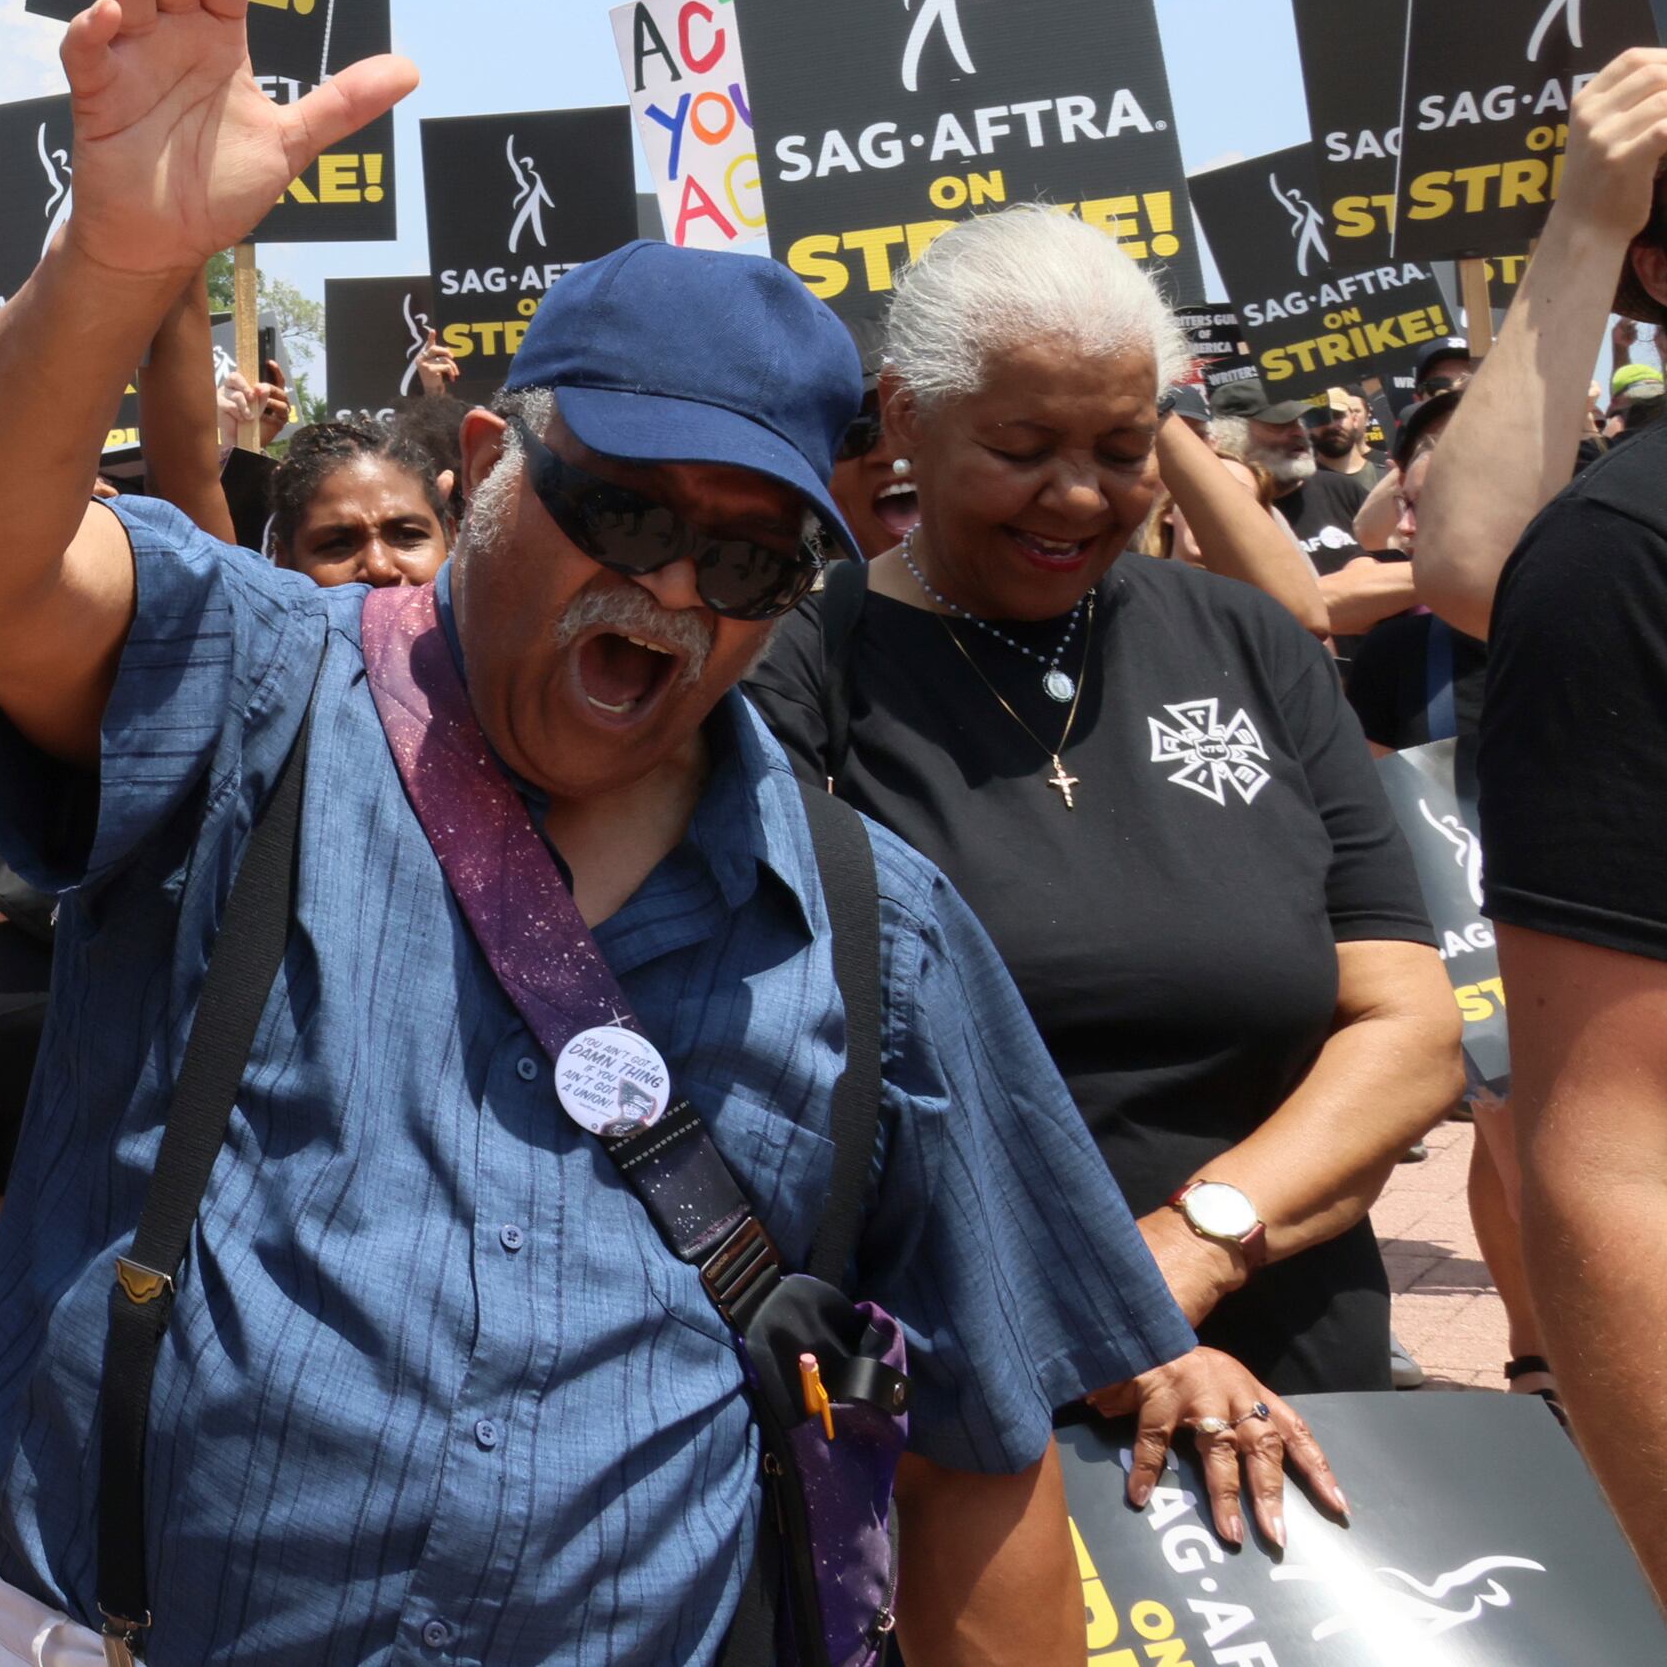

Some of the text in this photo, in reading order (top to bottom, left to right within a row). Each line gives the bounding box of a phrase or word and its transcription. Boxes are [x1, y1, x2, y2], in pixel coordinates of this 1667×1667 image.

[928, 171, 1006, 210] ON
[1324, 308, 1362, 329] ON
[1261, 305, 1448, 381] STRIKE!
[568, 1043, 664, 1089] DAMN THING
[583, 1036, 603, 1050] YOU
[630, 1053, 648, 1066] GOT
[651, 1063, 660, 1072] A
[594, 1081, 619, 1096] GOT
[597, 1068, 618, 1083] YOU
[573, 1087, 614, 1109] UNION!
